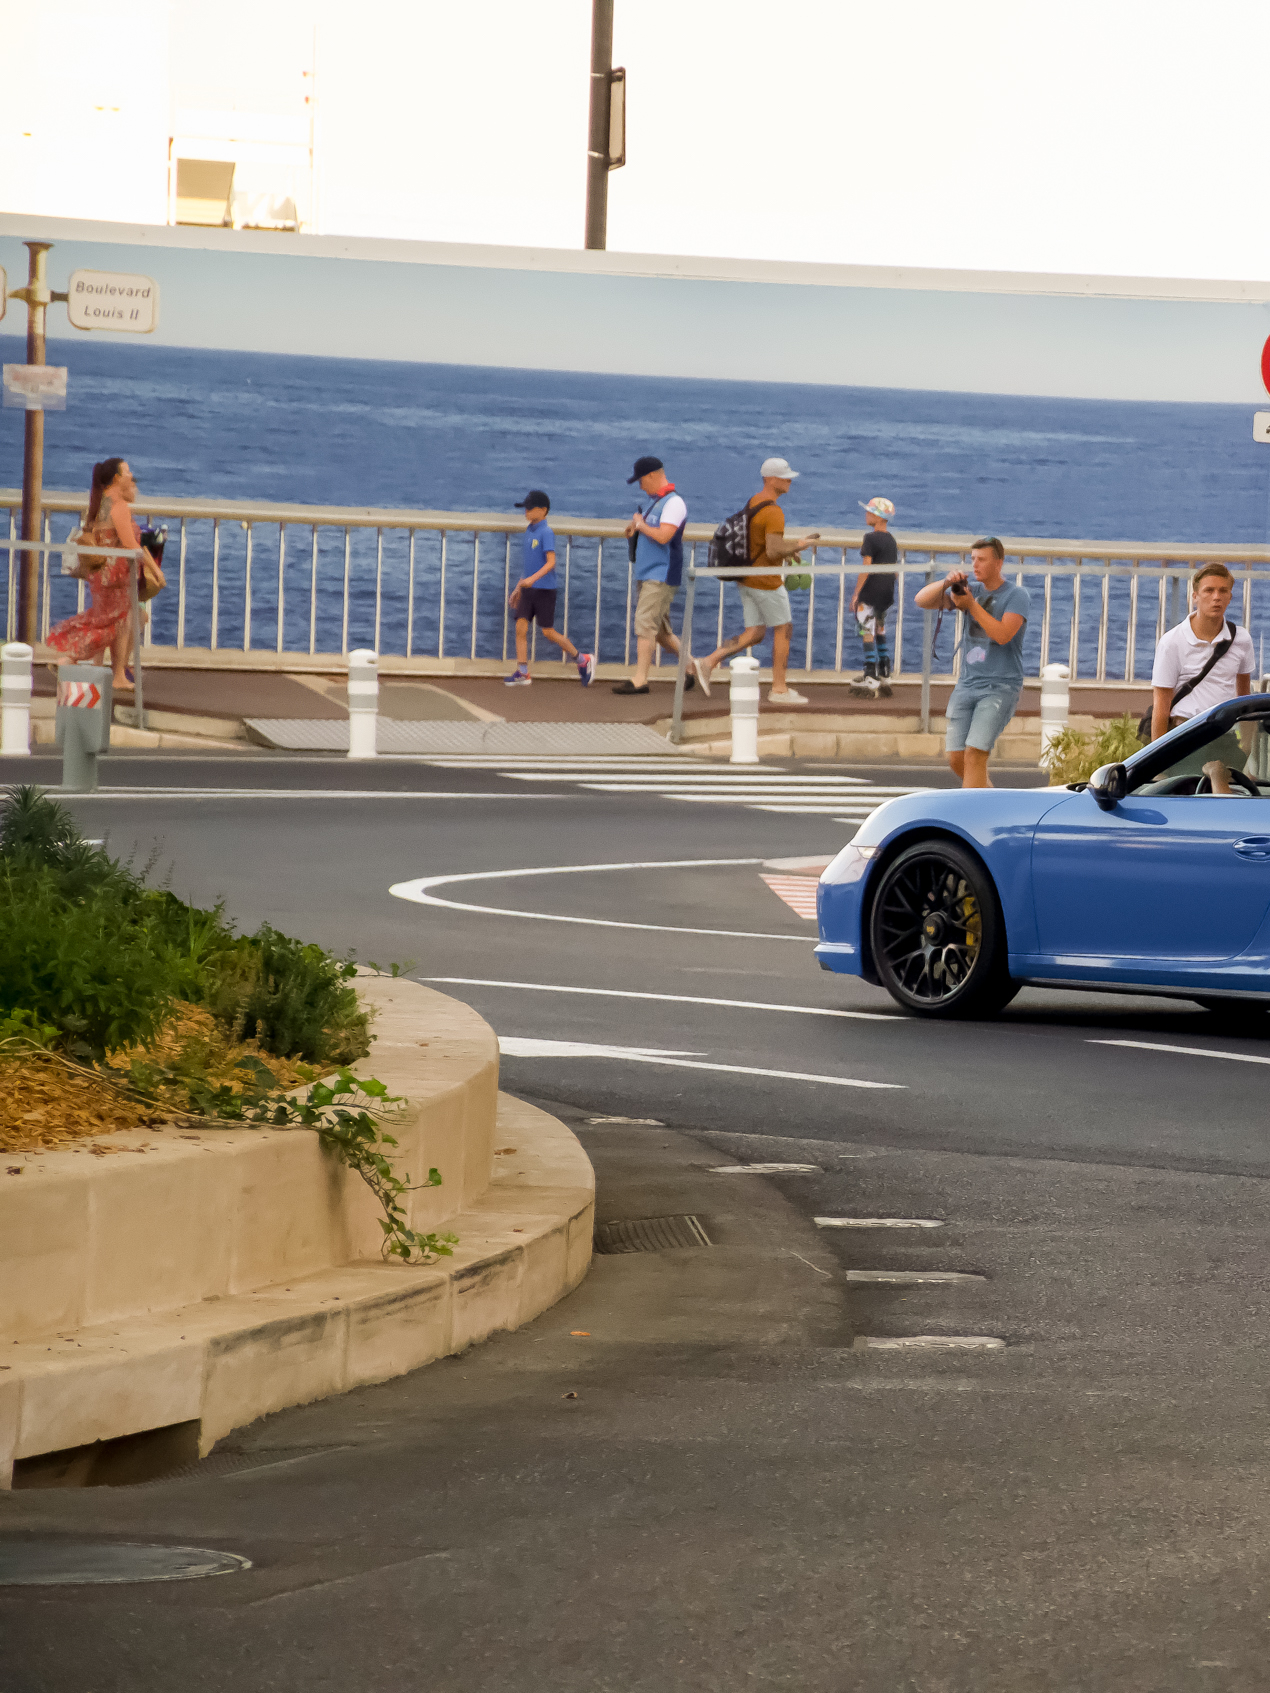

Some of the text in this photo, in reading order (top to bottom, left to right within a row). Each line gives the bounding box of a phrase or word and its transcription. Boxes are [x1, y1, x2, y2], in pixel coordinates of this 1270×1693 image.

[75, 280, 151, 299] Boulevard
[84, 305, 140, 321] Louis II
